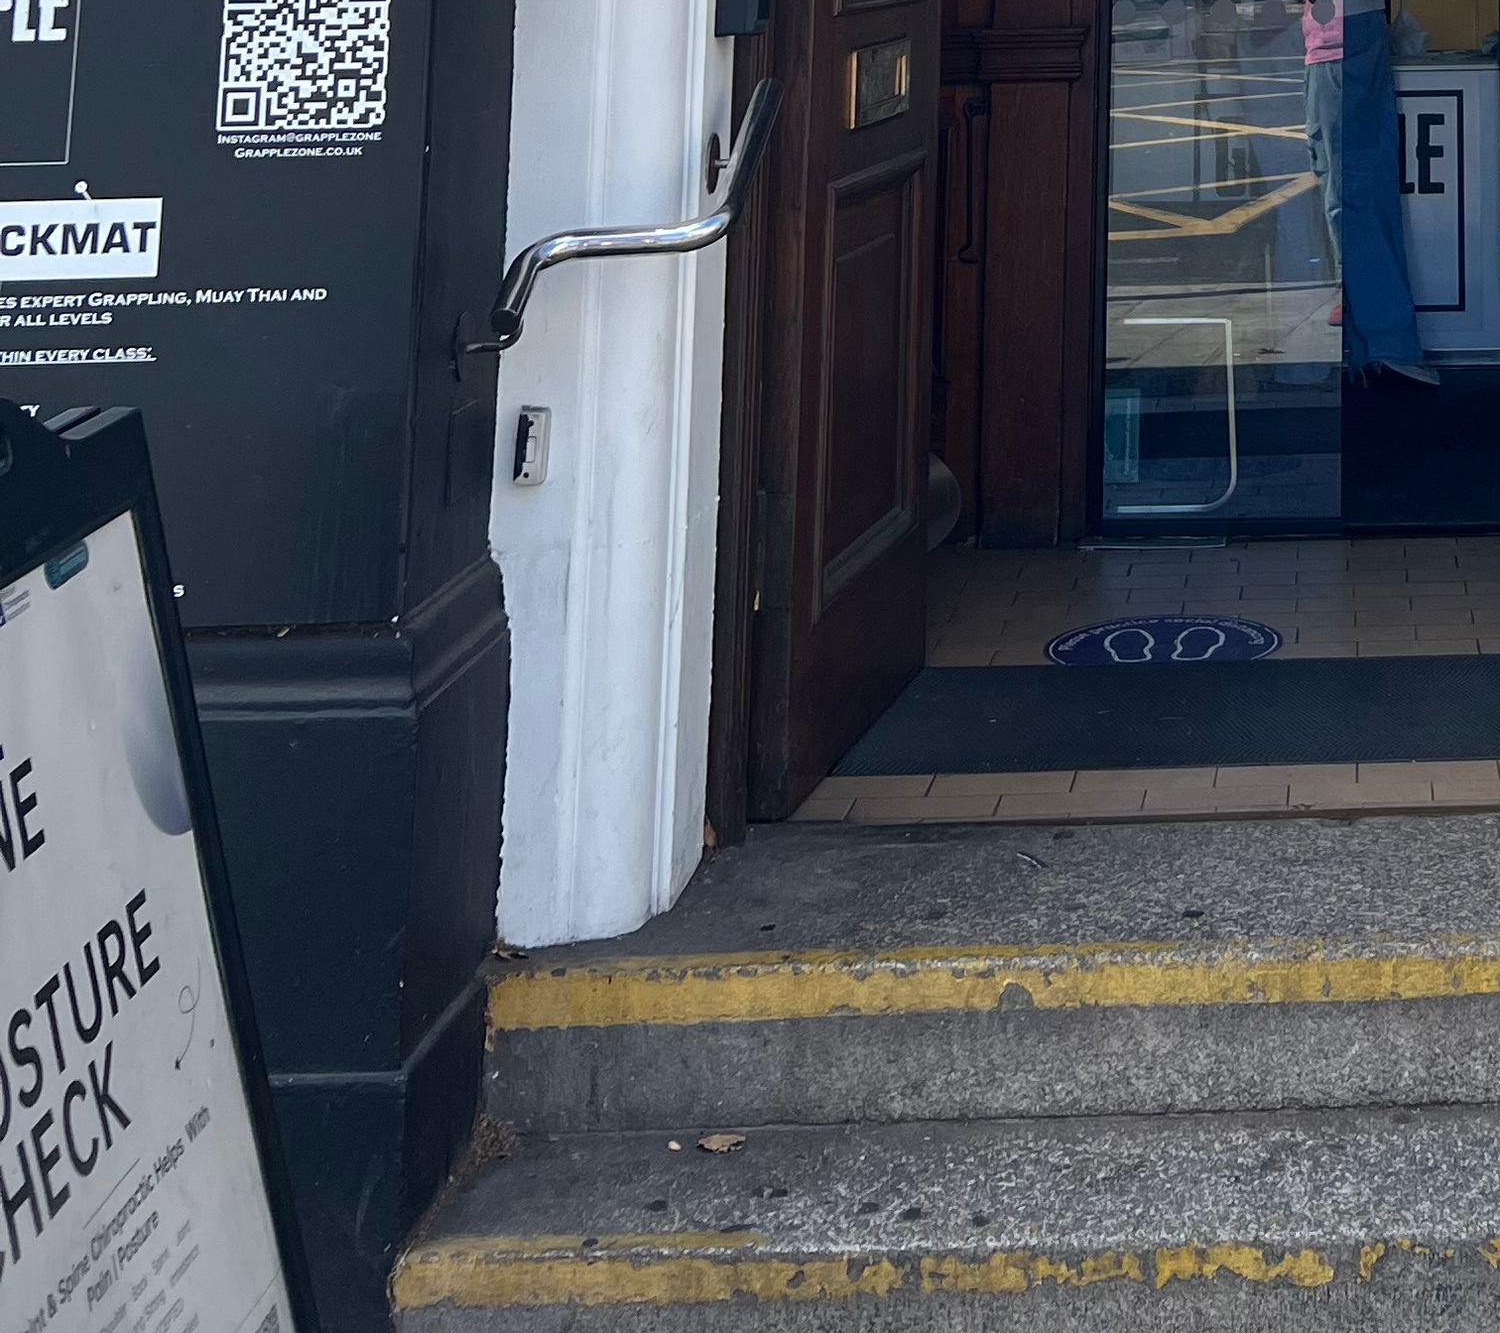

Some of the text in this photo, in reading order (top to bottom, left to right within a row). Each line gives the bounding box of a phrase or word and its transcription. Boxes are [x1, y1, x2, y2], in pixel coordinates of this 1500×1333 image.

[234, 146, 364, 159] GRAPPLEZONE.CO.UK
[0, 220, 158, 256] CKMAT
[20, 294, 87, 309] EXPERT
[88, 290, 192, 307] GRAPPLING,
[195, 289, 245, 304] MUAY
[247, 287, 288, 303] THAI
[290, 288, 328, 302] AND
[14, 314, 47, 328] ALL
[49, 312, 113, 326] LEVELS
[0, 347, 153, 363] HIN EVERY CLASS:
[0, 1039, 132, 1278] HECK
